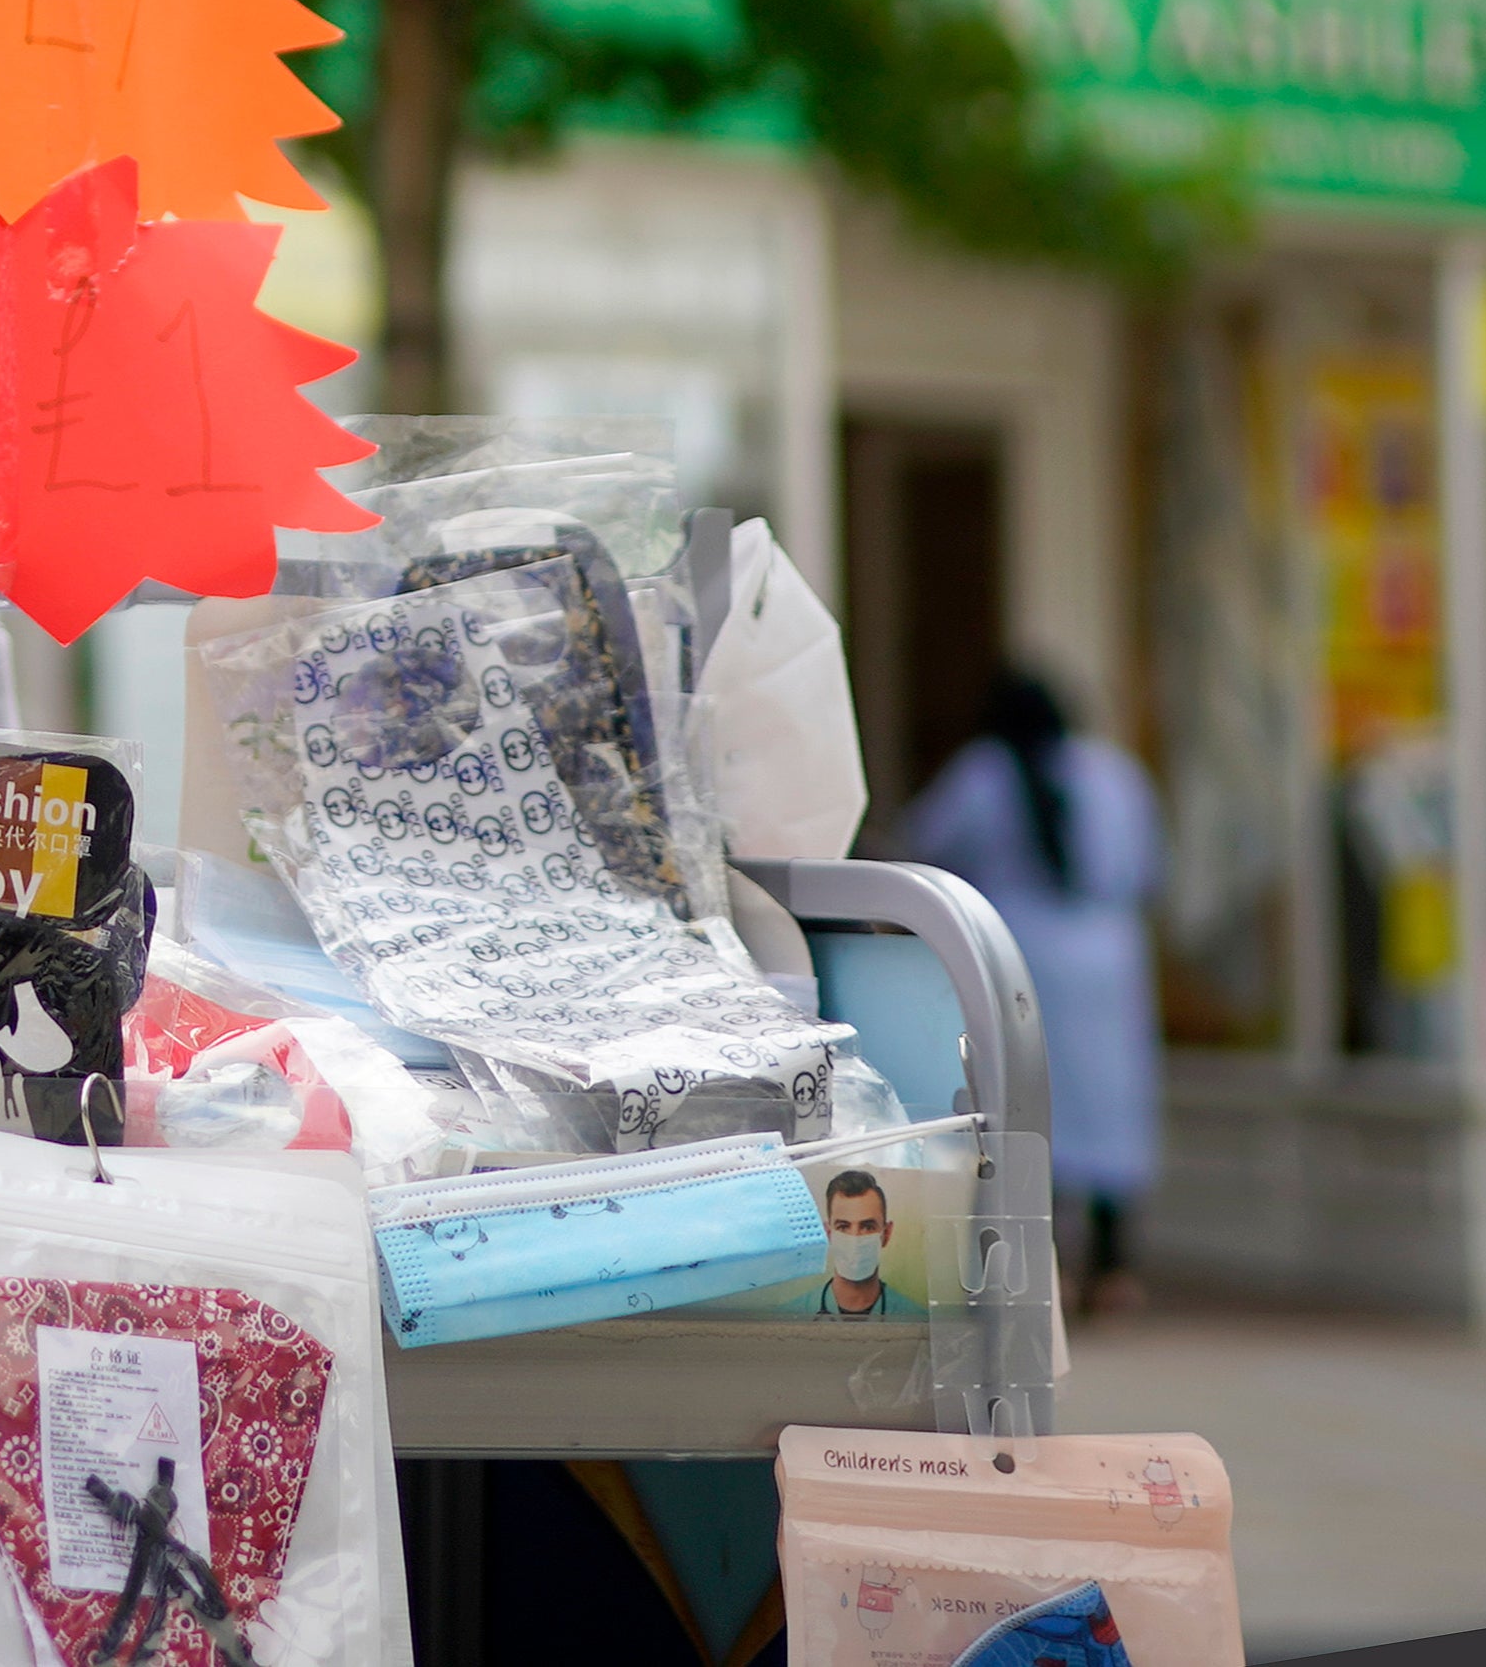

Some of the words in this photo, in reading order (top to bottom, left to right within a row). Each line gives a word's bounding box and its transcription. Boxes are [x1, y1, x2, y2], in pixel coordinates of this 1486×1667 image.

[90, 1346, 142, 1366] 合格证
[823, 1449, 913, 1474] Children's
[919, 1459, 969, 1477] mask
